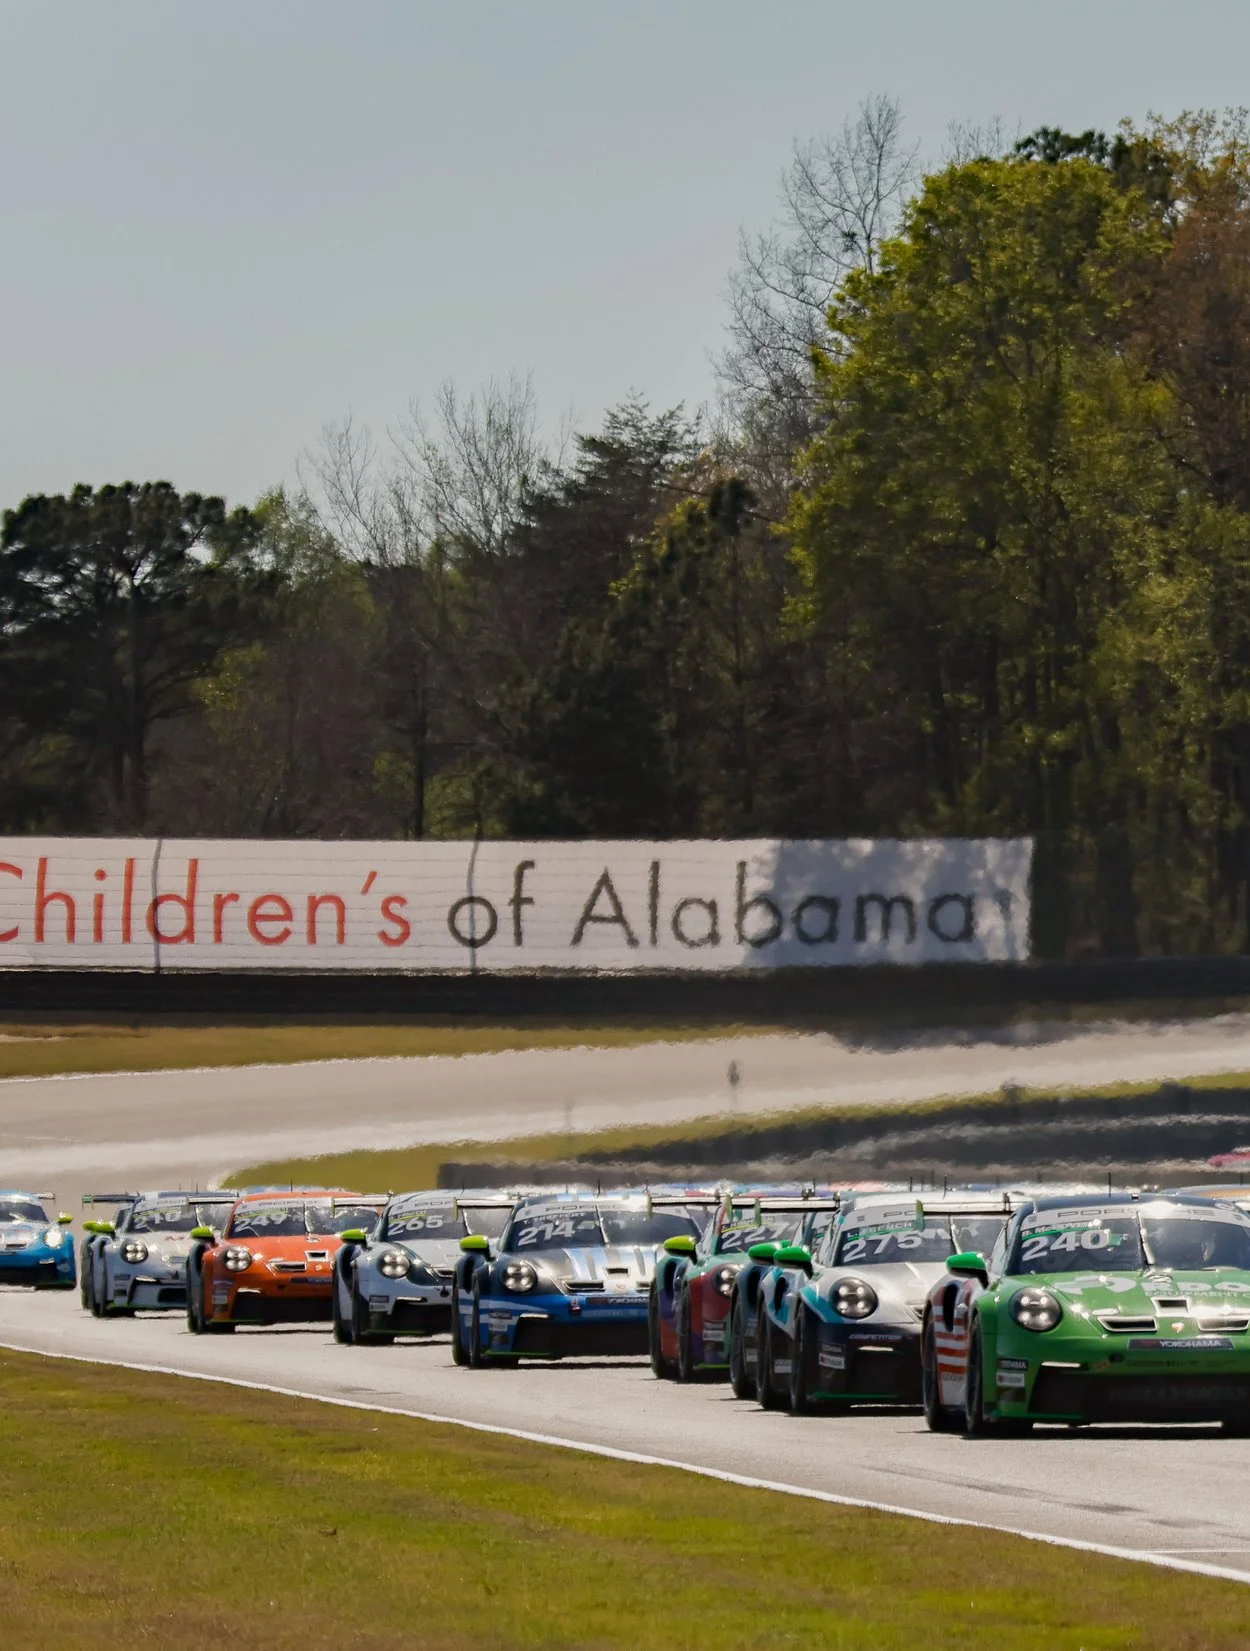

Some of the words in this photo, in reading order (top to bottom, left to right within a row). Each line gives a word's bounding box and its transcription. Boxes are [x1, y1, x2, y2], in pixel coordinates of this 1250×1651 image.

[447, 859, 536, 948] of
[569, 860, 977, 949] Alabama
[234, 1212, 288, 1233] 249
[387, 1214, 444, 1236] 265
[517, 1220, 576, 1247] 214
[722, 1222, 790, 1250] 227
[842, 1232, 923, 1264] 275
[1021, 1229, 1110, 1262] 240
[1159, 1339, 1222, 1348] YOKOHAMA
